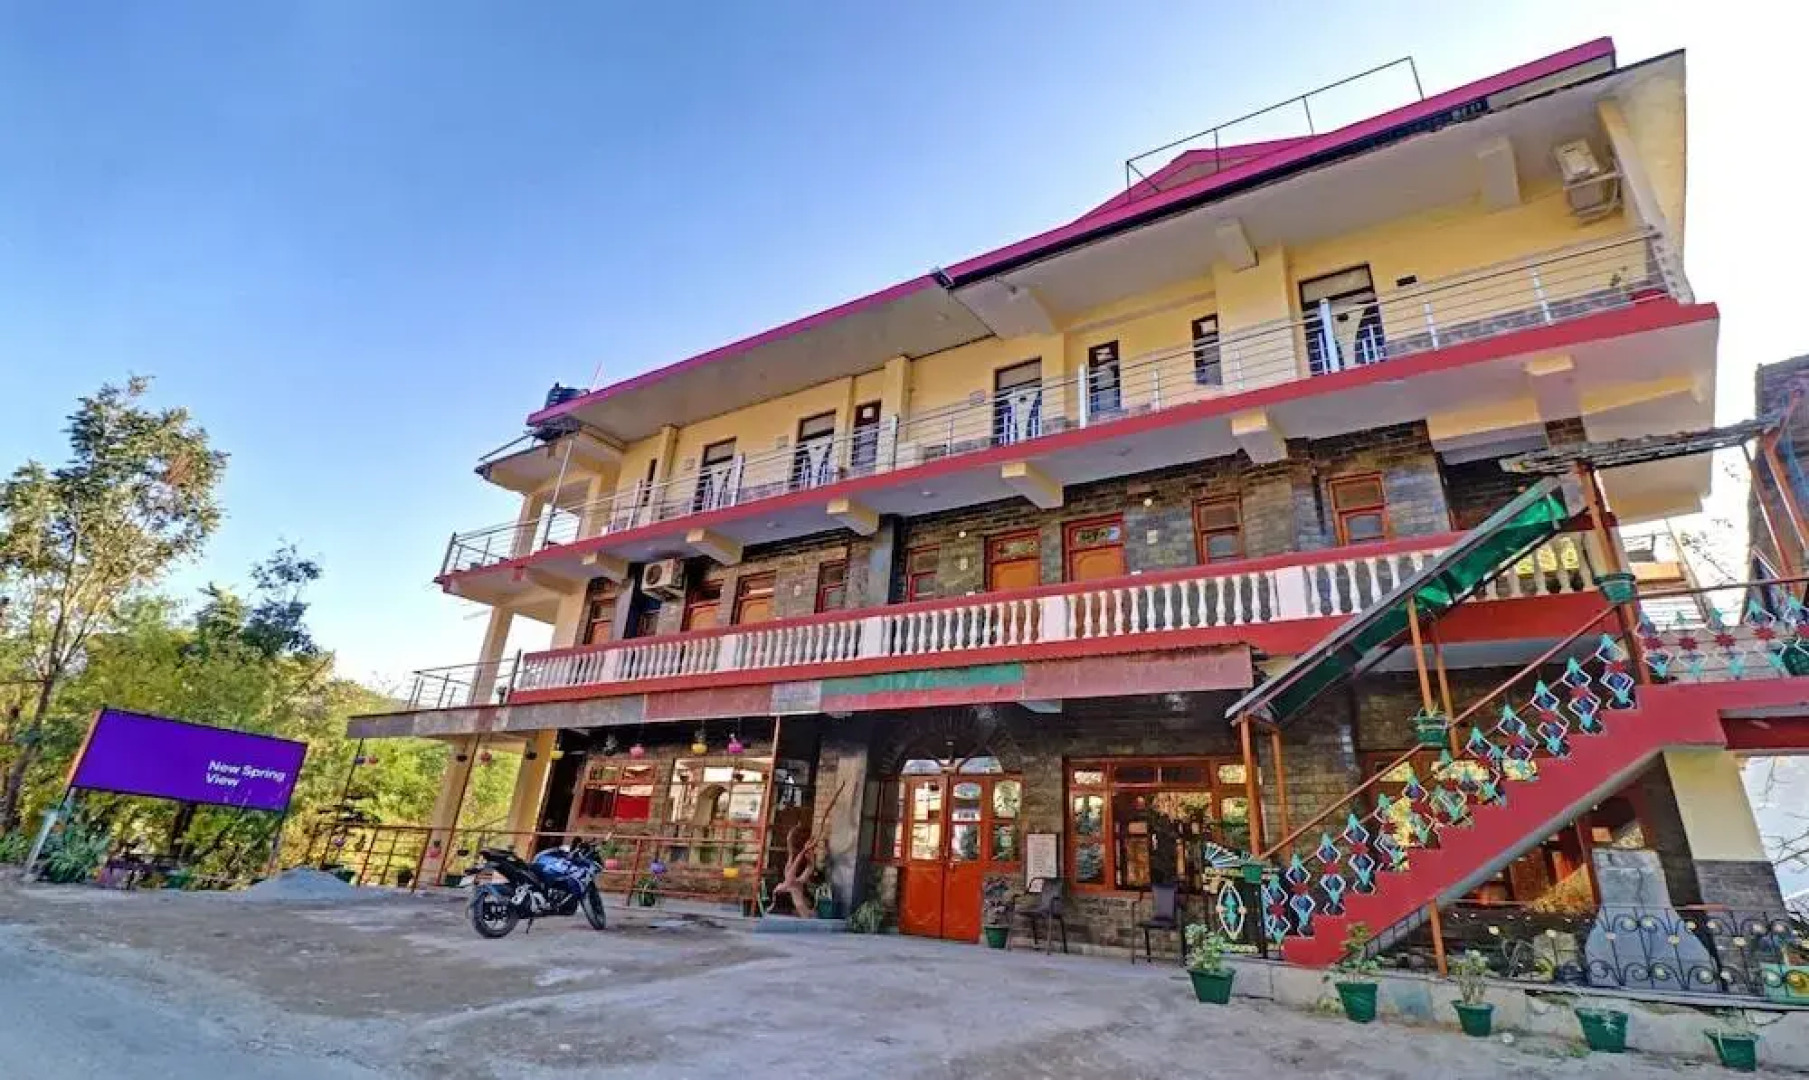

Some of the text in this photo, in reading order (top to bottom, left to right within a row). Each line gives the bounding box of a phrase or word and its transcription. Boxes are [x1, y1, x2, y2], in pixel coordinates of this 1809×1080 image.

[206, 772, 239, 787] View
[208, 760, 286, 782] New Spring
